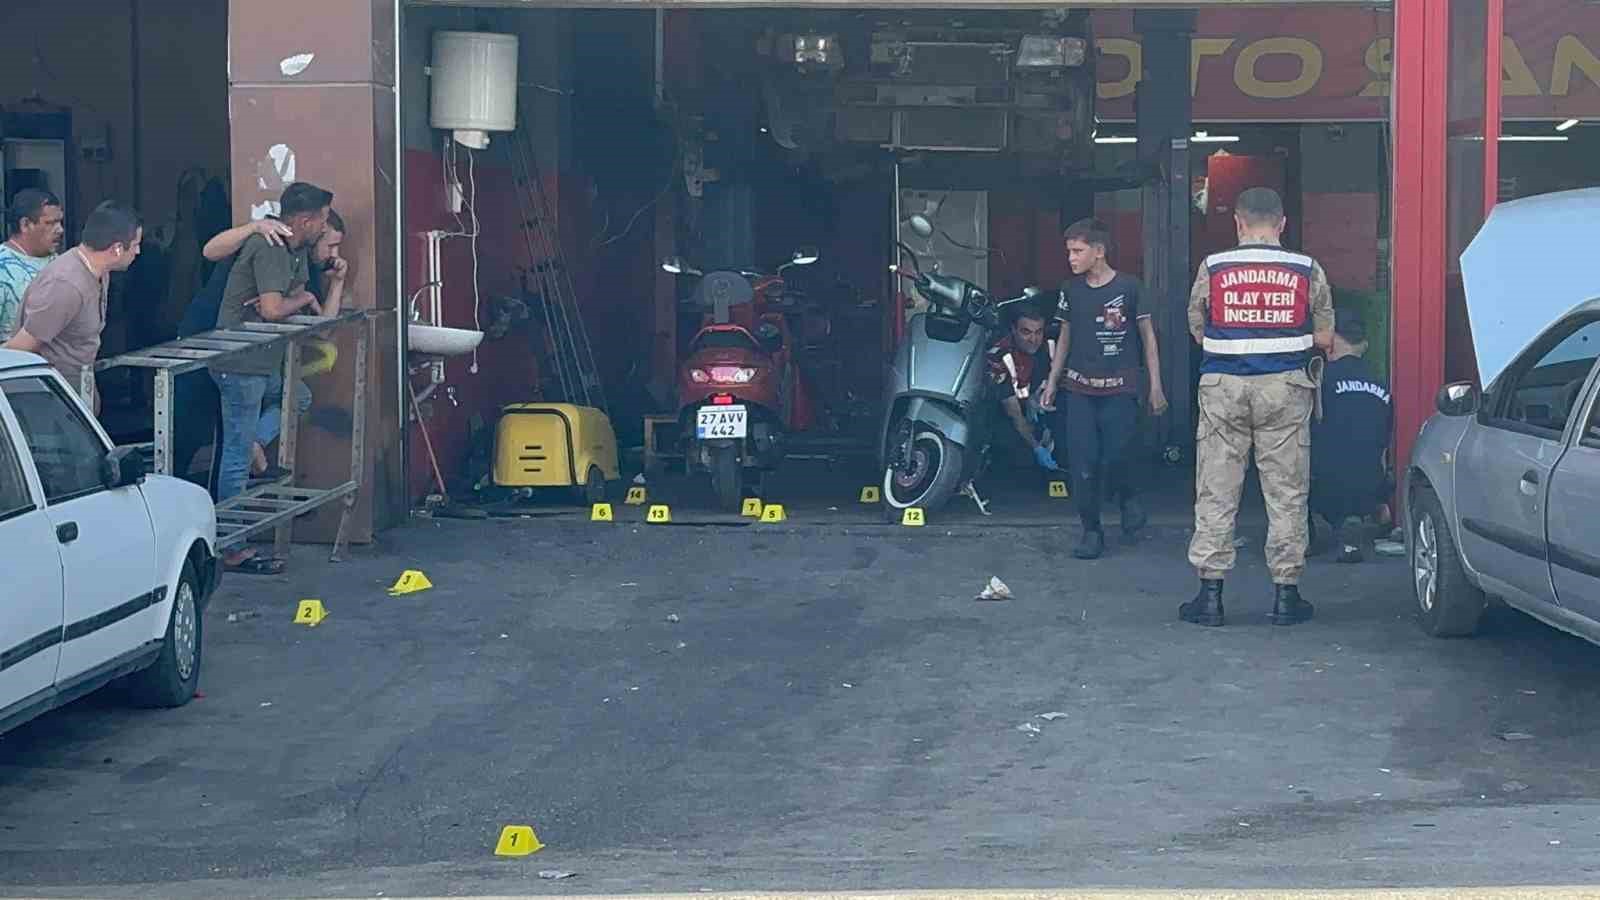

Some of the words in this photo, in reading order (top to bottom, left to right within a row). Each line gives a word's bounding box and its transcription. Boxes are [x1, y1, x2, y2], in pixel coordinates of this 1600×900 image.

[1220, 269, 1299, 289] JANDARMA
[1223, 290, 1260, 306] OLAY
[1262, 289, 1296, 306] YERİ
[1223, 306, 1295, 323] İNCELEME
[1335, 380, 1390, 405] JANDARMA
[700, 413, 717, 425] 27
[719, 412, 744, 424] AVV
[711, 425, 735, 436] 442
[652, 510, 664, 519] 13
[907, 511, 920, 521] 12
[303, 607, 312, 618] 2
